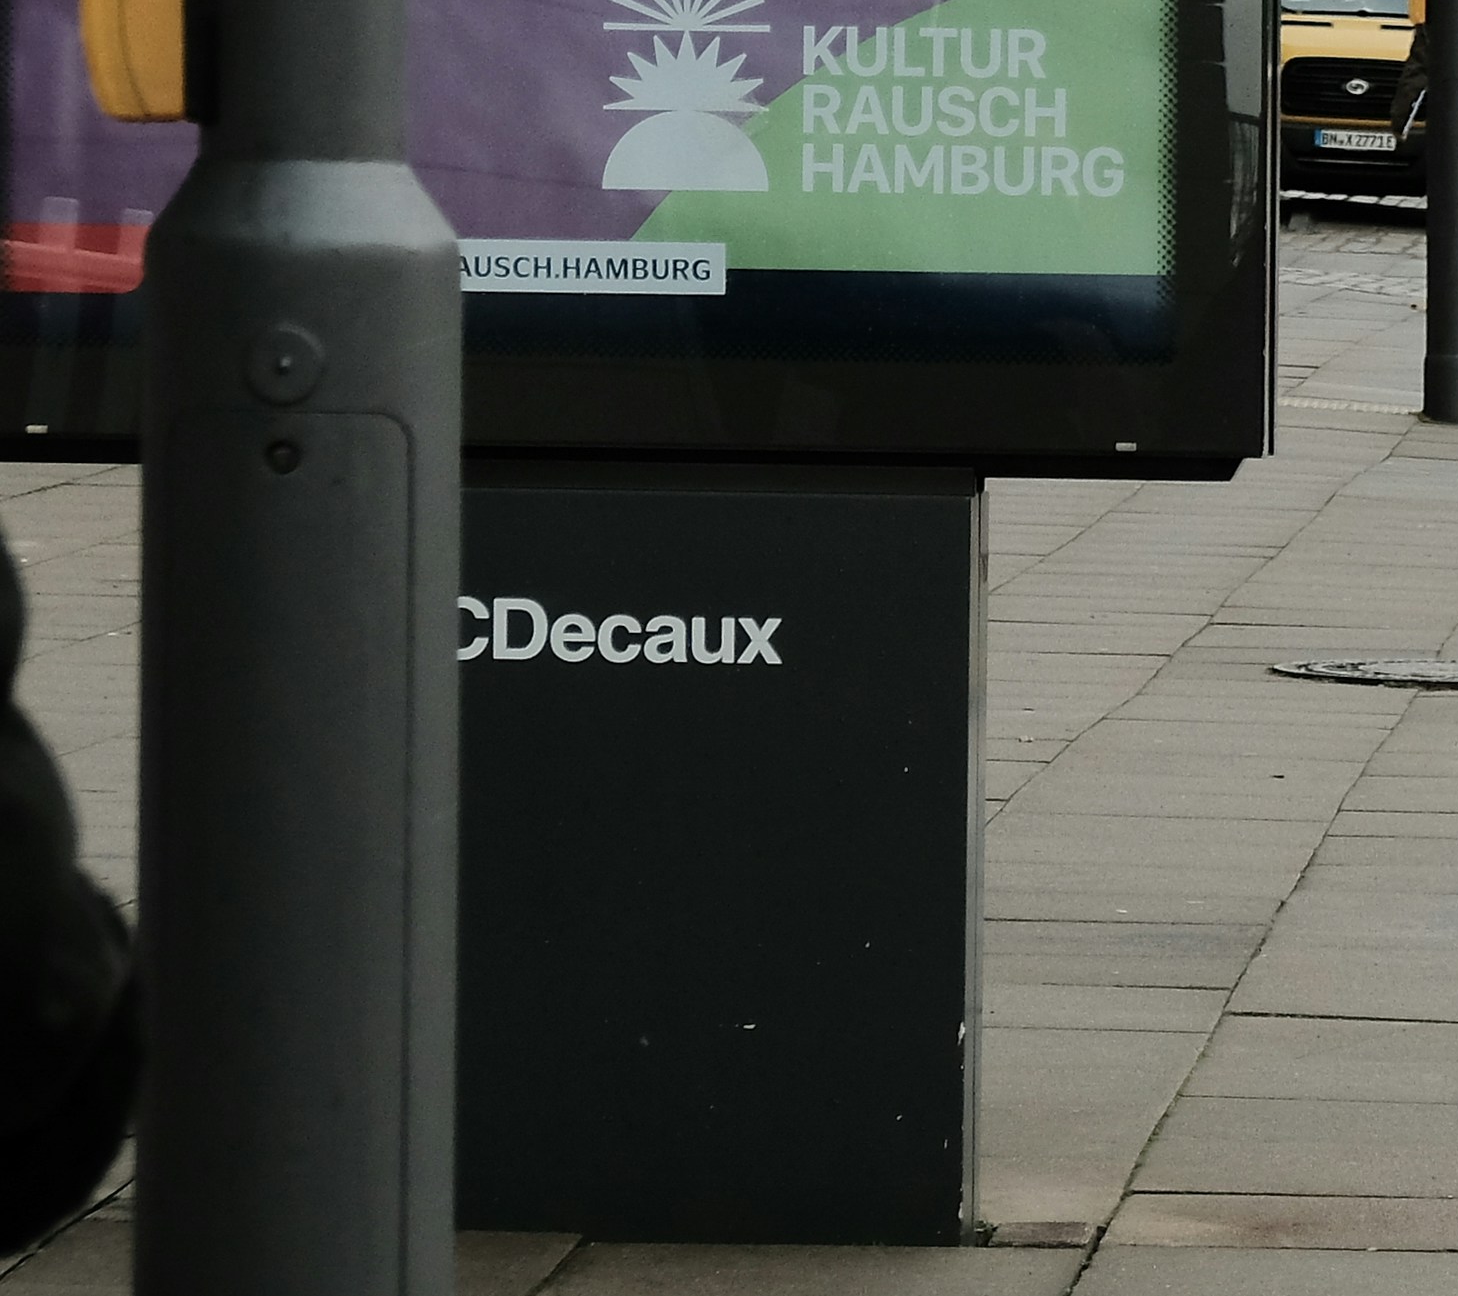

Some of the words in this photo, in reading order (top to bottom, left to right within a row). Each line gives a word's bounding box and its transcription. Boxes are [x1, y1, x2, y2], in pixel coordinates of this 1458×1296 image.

[803, 25, 1047, 78] KULTUR
[802, 84, 1067, 138] RAUSCH
[802, 143, 1125, 197] HAMBURG
